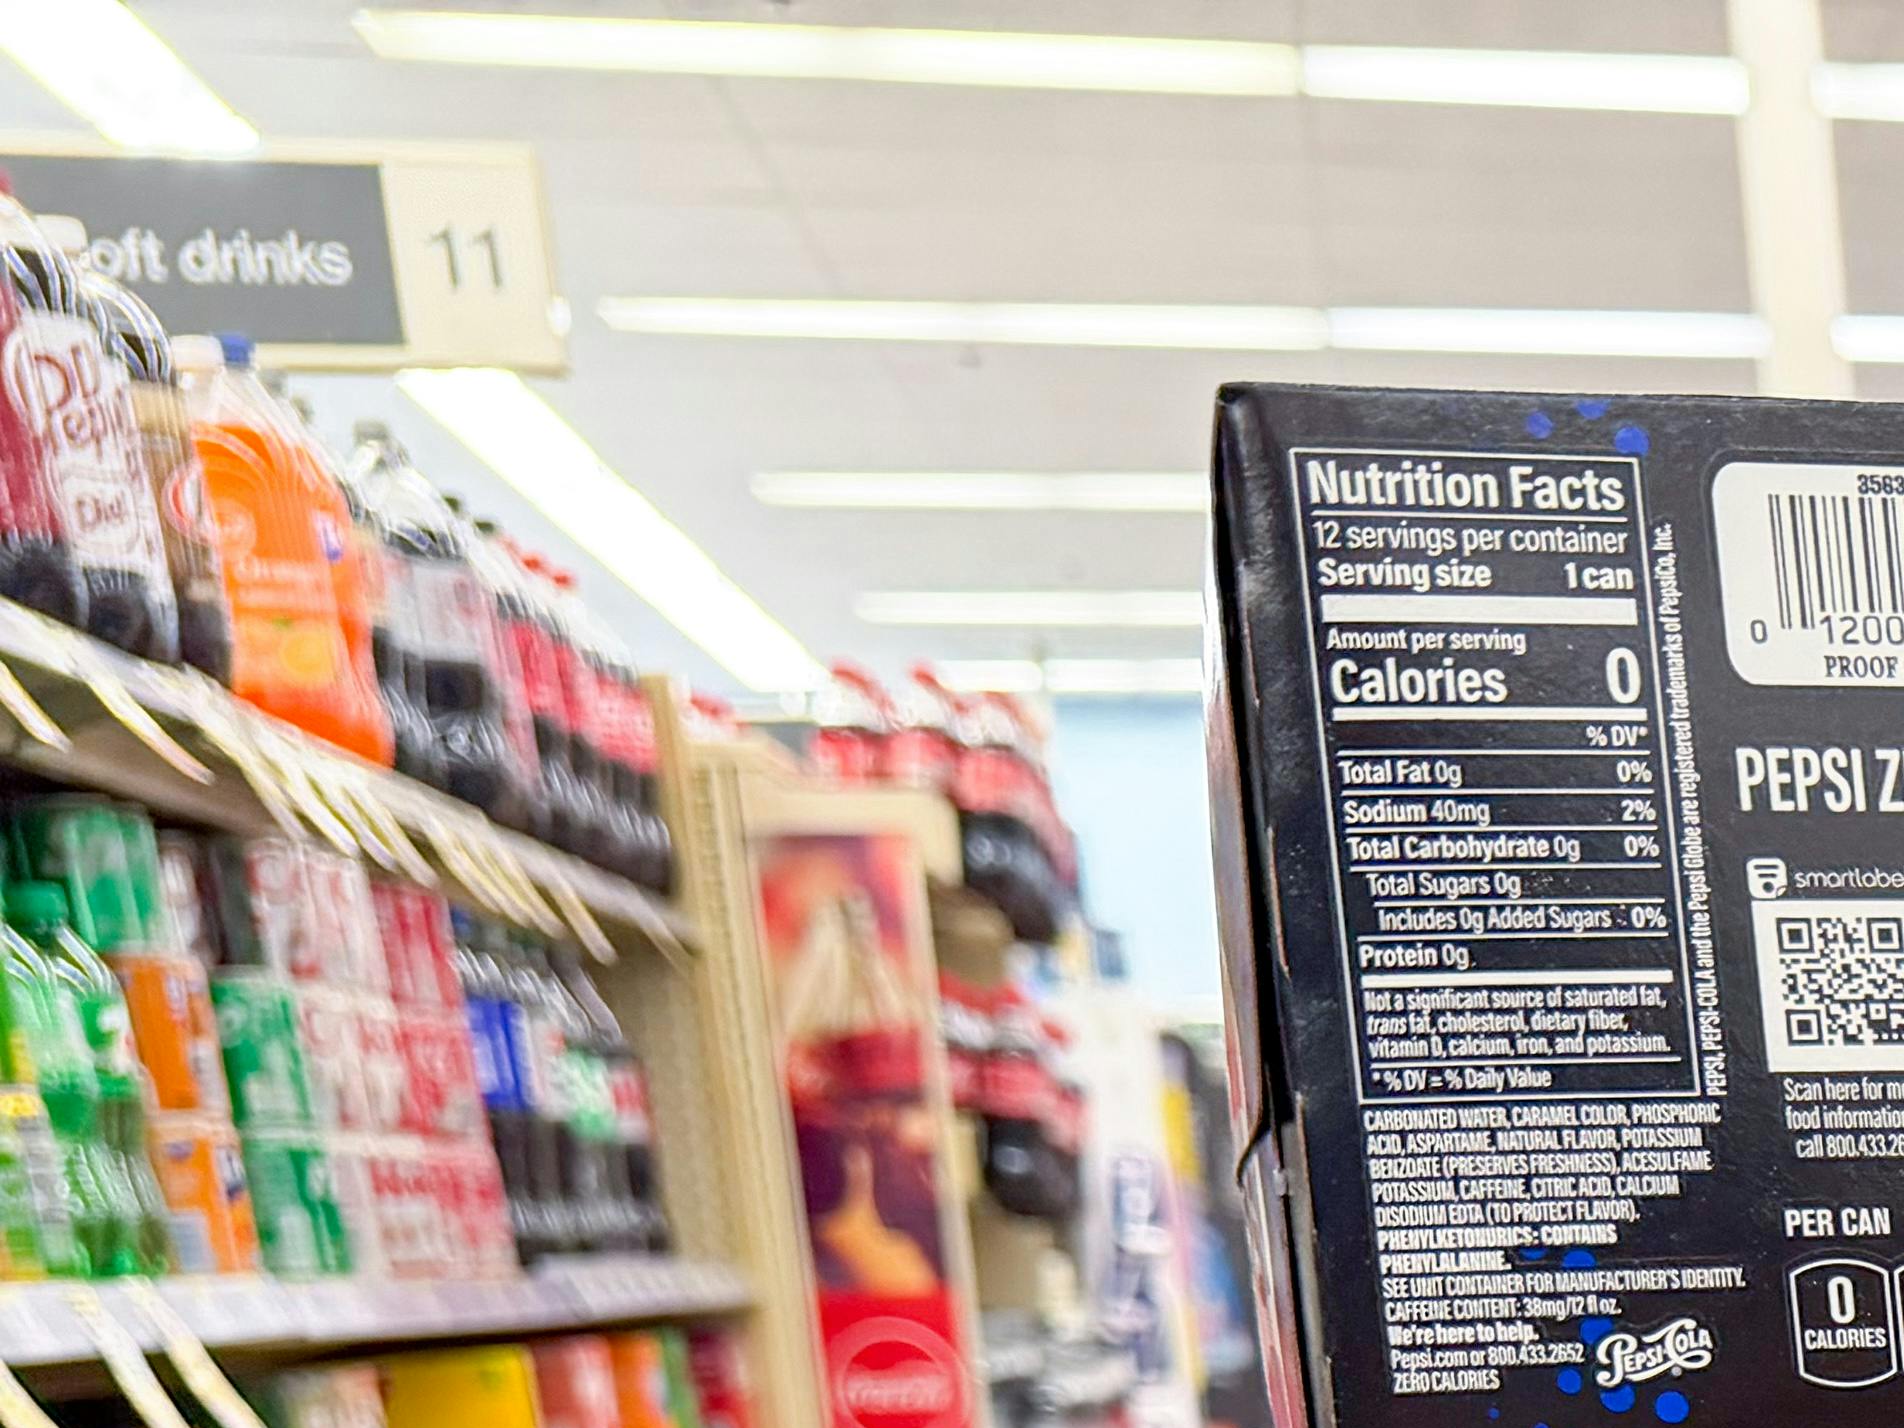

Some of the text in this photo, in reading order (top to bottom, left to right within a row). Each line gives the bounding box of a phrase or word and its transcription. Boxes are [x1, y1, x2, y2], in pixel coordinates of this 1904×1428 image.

[89, 226, 354, 286] oft drinks
[426, 221, 505, 291] 11
[1307, 460, 1626, 511] Nutrition Facts
[1312, 521, 1627, 555] 12 servings per container
[1318, 559, 1492, 591] Serving size
[1564, 564, 1633, 590] 1 can
[1326, 628, 1526, 655] Amount per serving
[1751, 618, 1767, 645] 0
[1331, 648, 1641, 703] Calories 0
[1824, 655, 1898, 679] PROOF
[1338, 760, 1652, 786] Total Fat 0g 0%
[1736, 747, 1867, 812] PEPSI
[1344, 801, 1656, 825] Sodium 40mg 2%
[1347, 836, 1659, 861] Total Carbohydrate 0g 0%
[1379, 908, 1666, 934] Includes 0g Added Sugars 0%
[1360, 944, 1470, 969] Protein 0g
[1785, 1079, 1822, 1101] Scan
[1825, 1079, 1861, 1101] here
[1863, 1079, 1886, 1101] for
[1785, 1207, 1891, 1237] PER CAN
[1828, 1276, 1854, 1325] 0
[1804, 1326, 1886, 1352] CALORIES
[1393, 1370, 1500, 1394] ZERO CALORIES
